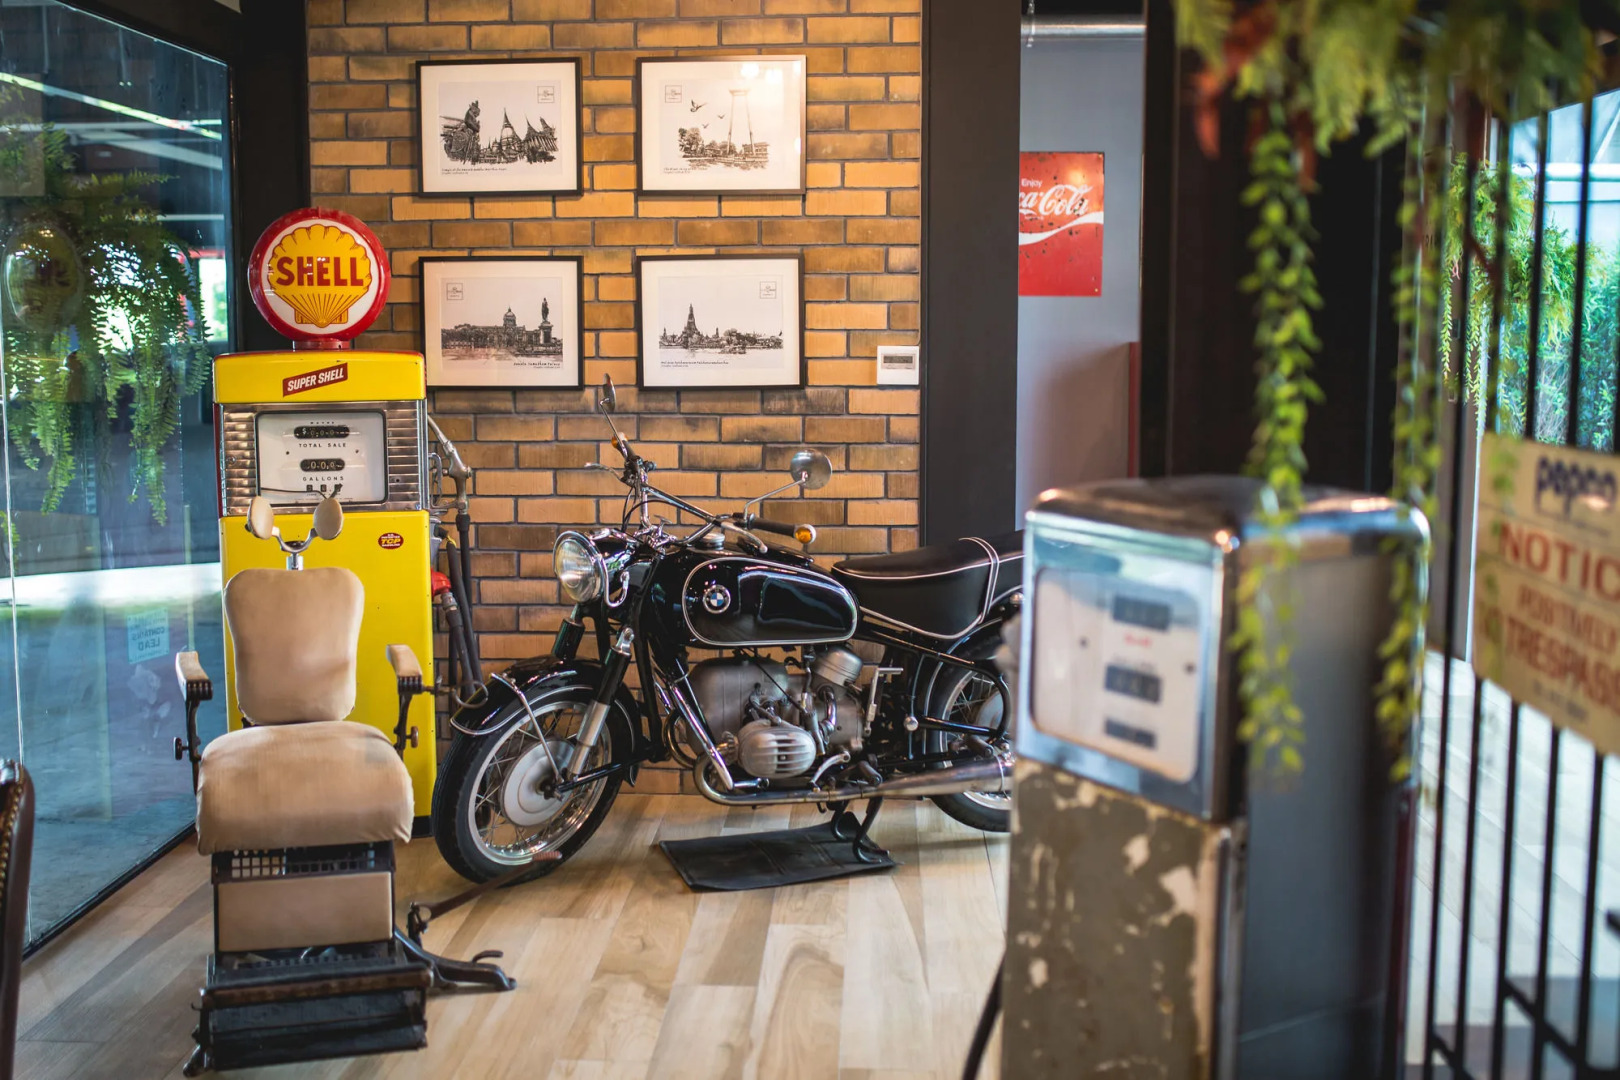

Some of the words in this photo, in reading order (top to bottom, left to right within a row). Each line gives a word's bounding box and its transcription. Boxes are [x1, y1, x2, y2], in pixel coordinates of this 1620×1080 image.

[1021, 178, 1042, 188] Enjoy
[275, 255, 364, 287] SHELL
[287, 374, 317, 392] SUPER
[317, 367, 344, 384] SHELL
